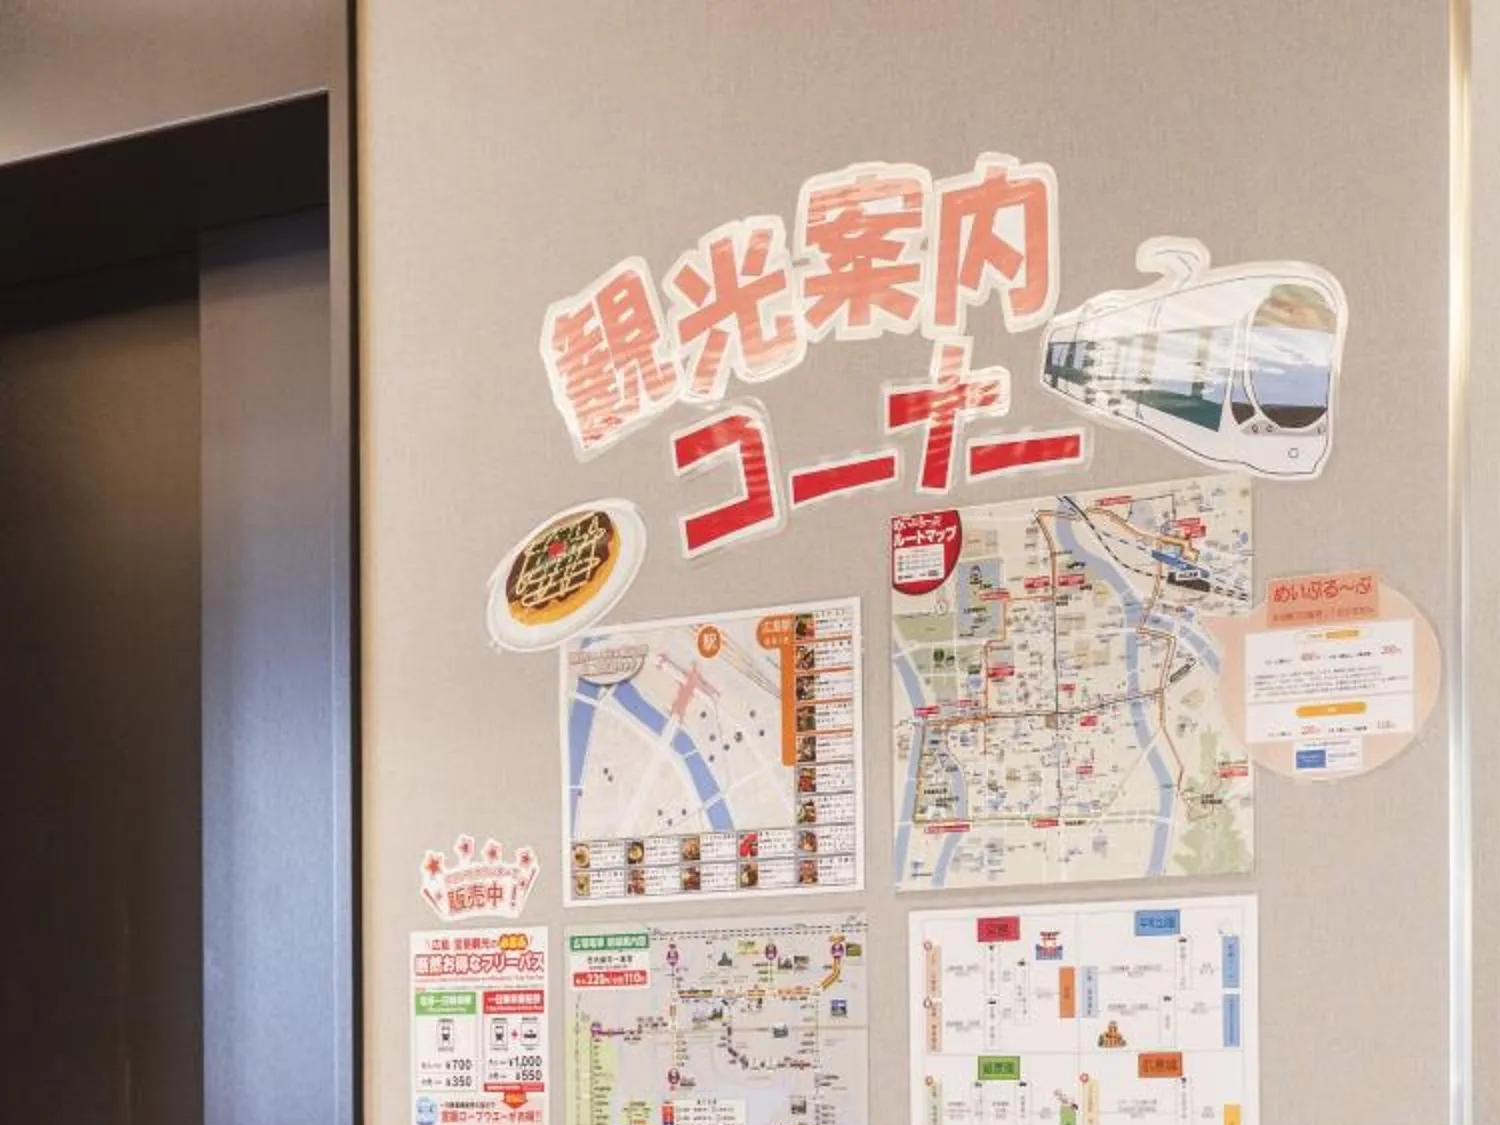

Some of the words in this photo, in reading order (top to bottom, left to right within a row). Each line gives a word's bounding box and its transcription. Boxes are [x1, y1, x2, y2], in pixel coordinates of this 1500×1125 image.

[552, 163, 1049, 446] 観光案内
[674, 346, 1082, 551] コーナー
